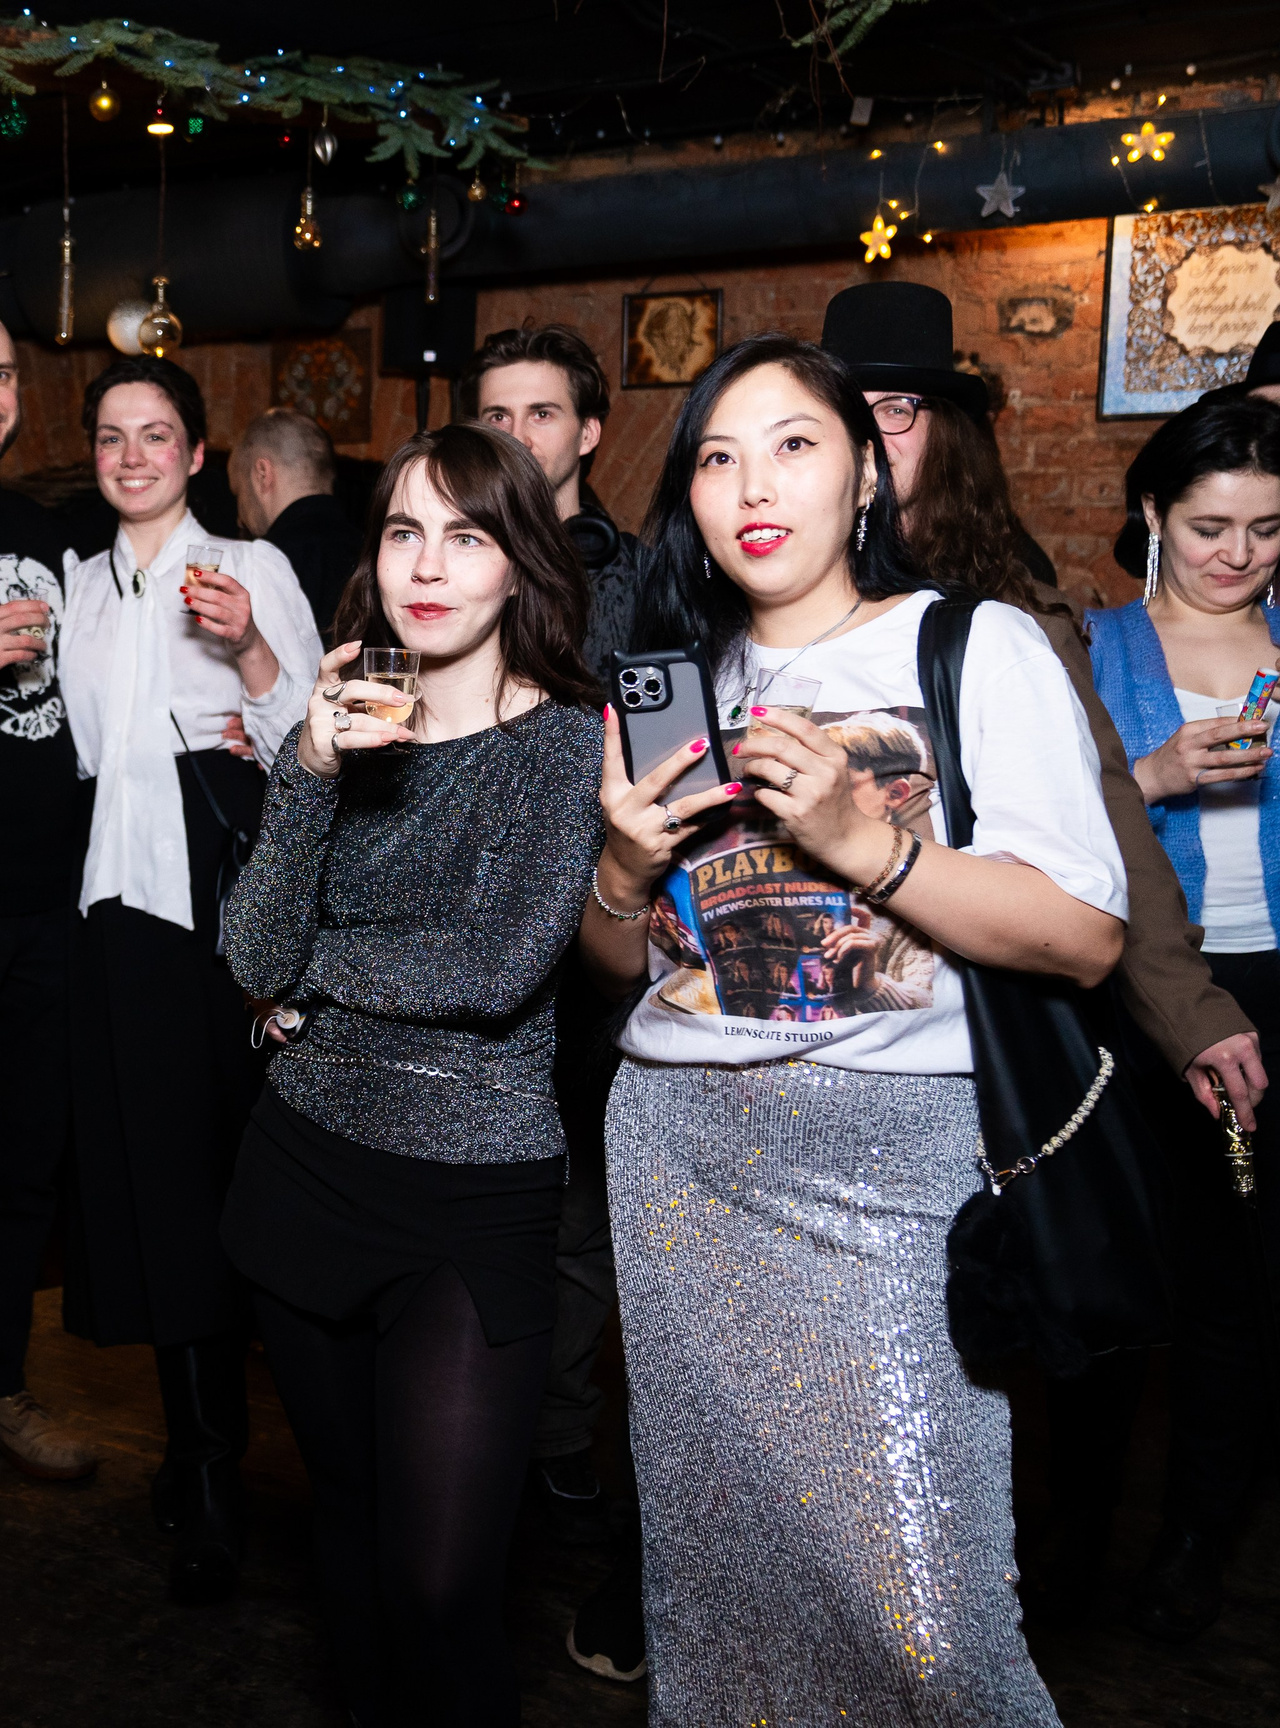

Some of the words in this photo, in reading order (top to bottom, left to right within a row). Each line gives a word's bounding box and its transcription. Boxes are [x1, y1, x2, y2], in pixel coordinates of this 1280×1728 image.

[696, 847, 815, 892] PLAYBO
[700, 882, 782, 911] BROADCAST
[701, 909, 715, 922] TV
[715, 896, 783, 917] NEWSCASTER
[783, 895, 824, 907] BARES
[825, 895, 847, 907] ALL
[724, 1026, 782, 1041] LEMINSCATE
[784, 1031, 834, 1043] STUDIO
